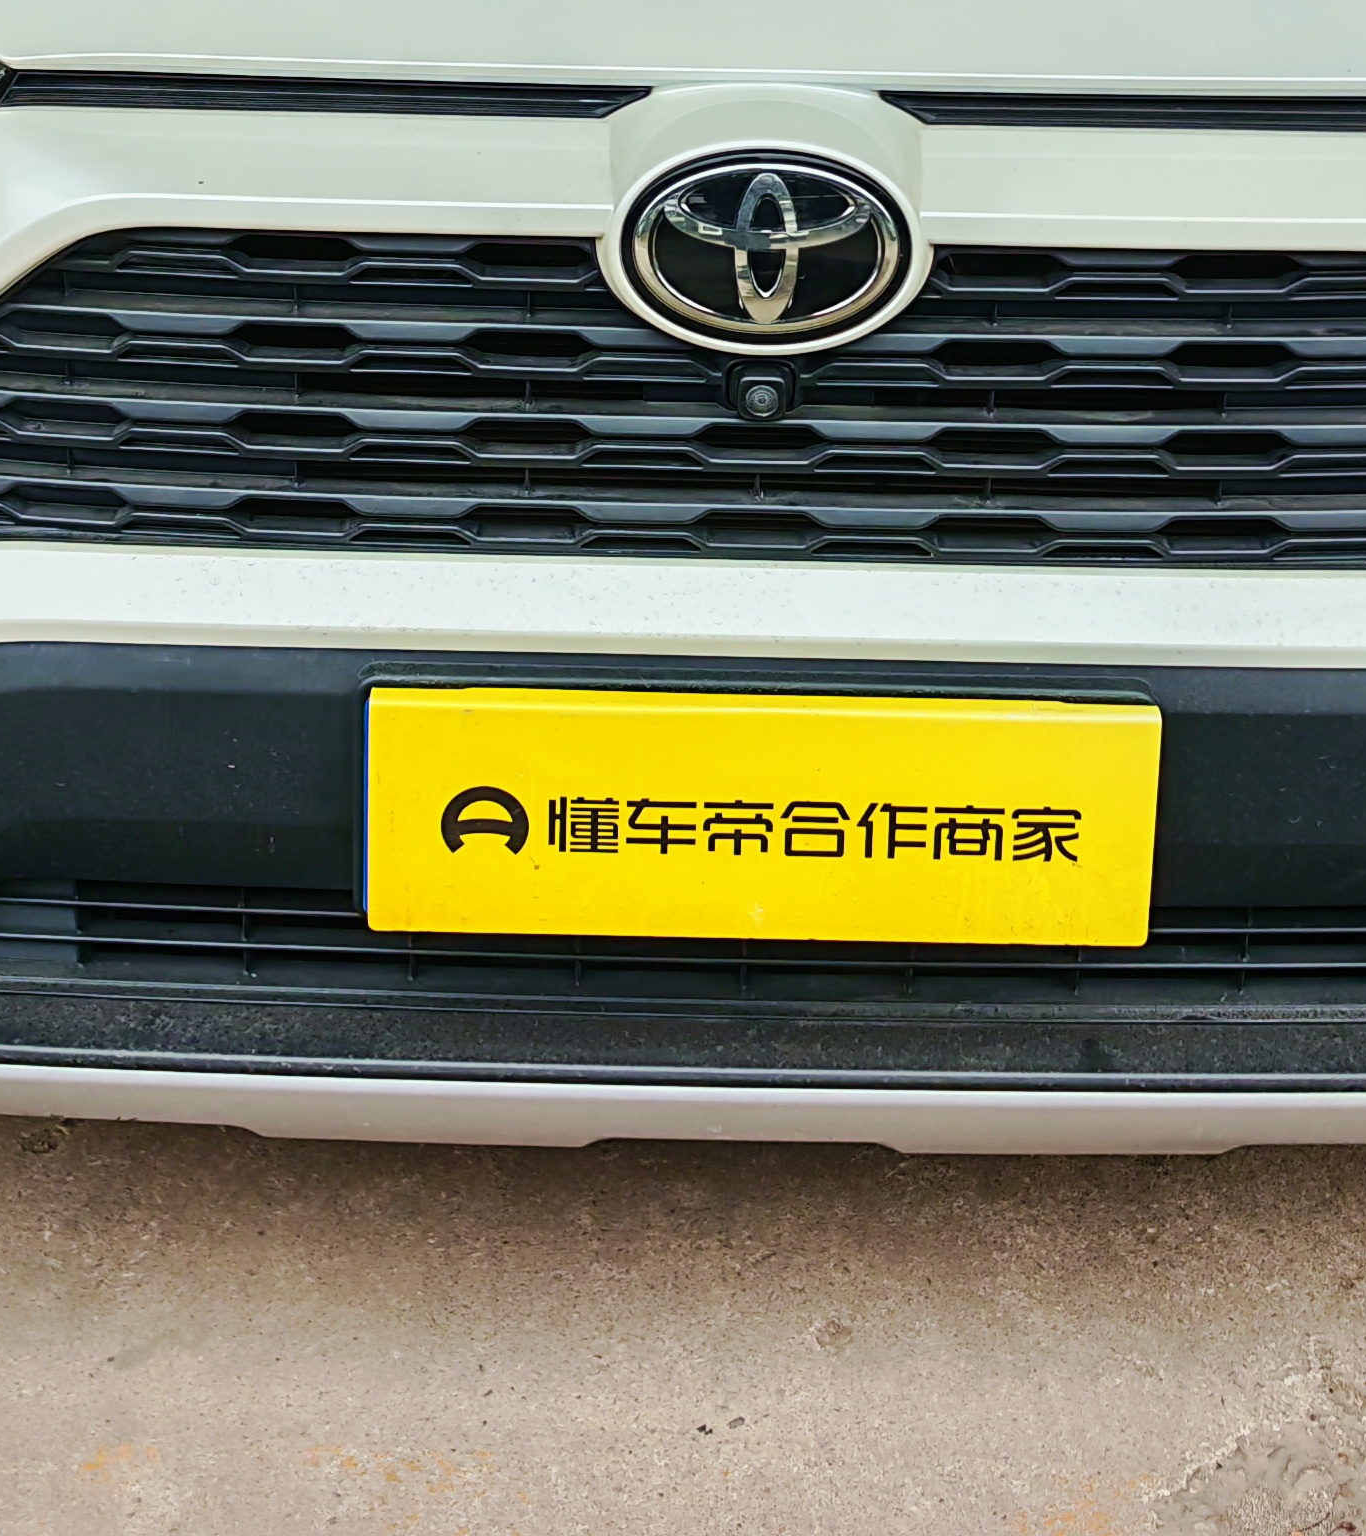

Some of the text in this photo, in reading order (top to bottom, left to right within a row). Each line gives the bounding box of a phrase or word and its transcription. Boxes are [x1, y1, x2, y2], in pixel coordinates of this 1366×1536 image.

[548, 796, 1082, 864] 懂车帝合作商家
